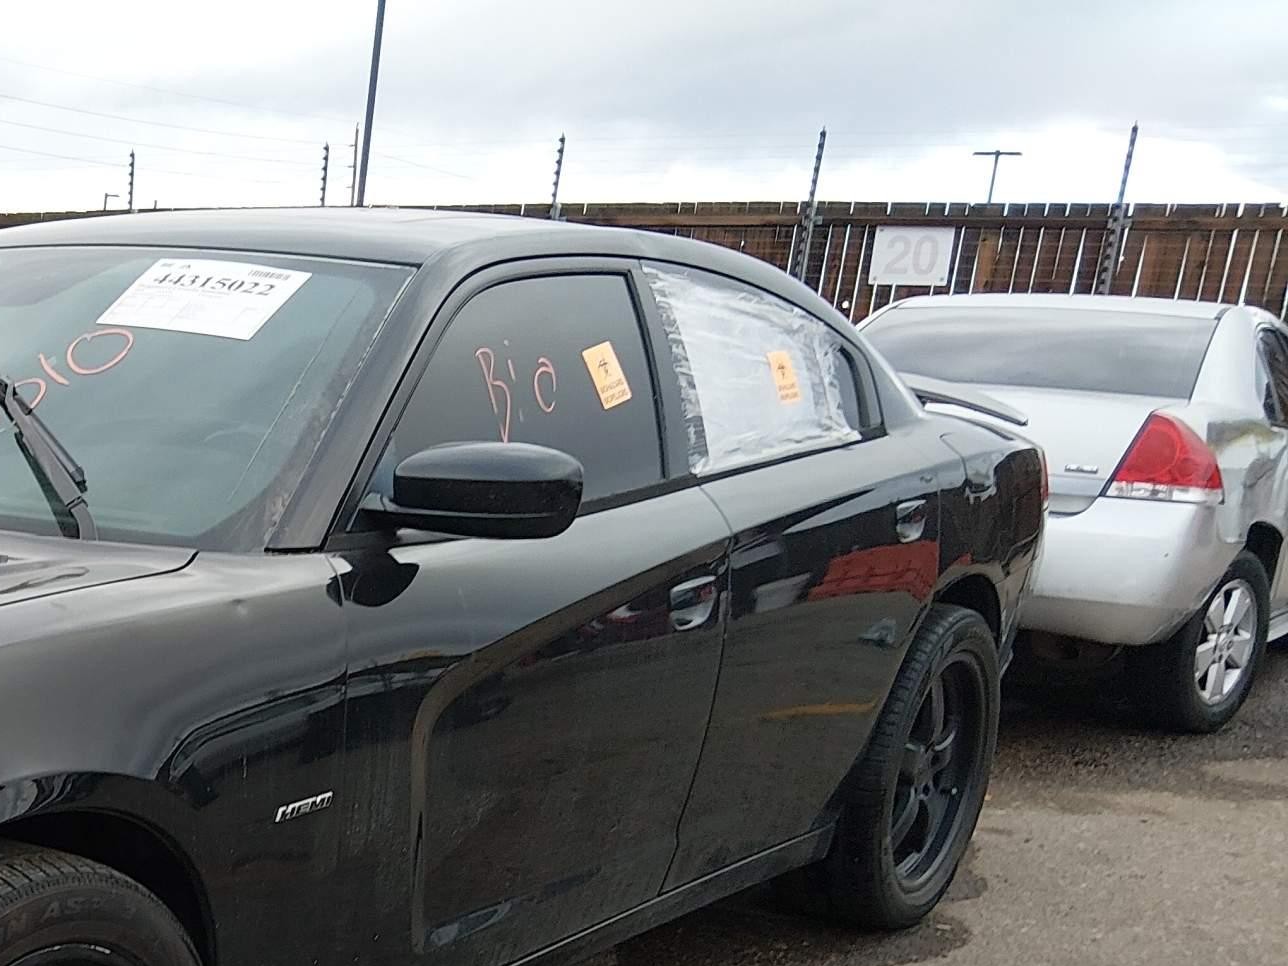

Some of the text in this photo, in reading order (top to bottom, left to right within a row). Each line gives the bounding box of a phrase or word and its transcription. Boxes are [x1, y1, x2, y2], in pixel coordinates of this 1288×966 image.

[883, 235, 938, 275] 20
[153, 273, 275, 296] 44315022
[274, 791, 334, 823] HEMI
